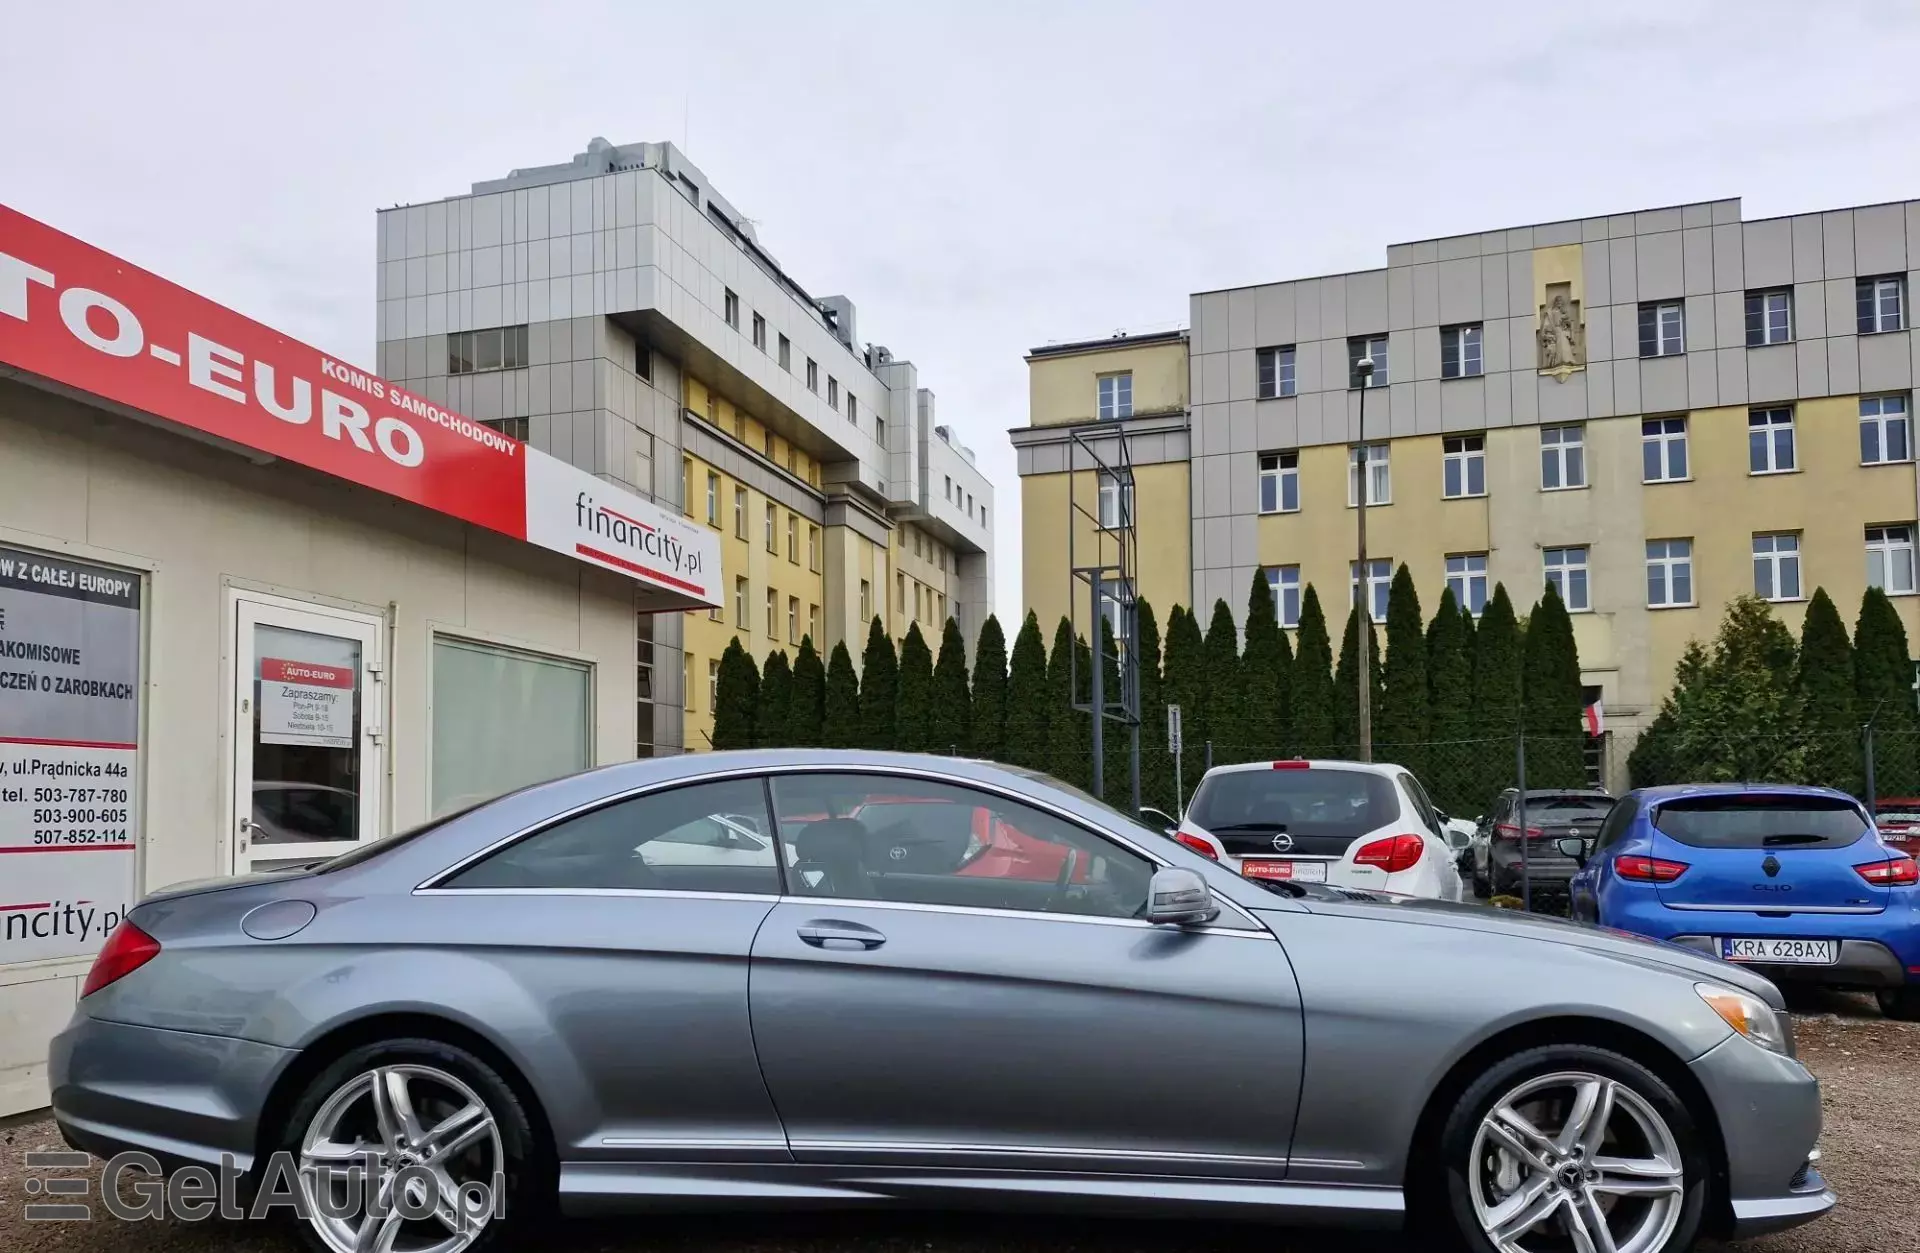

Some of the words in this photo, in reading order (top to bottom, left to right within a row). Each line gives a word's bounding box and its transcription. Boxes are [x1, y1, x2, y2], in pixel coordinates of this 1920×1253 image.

[321, 357, 384, 399] KOMIS
[390, 388, 516, 457] SAMOCHODOWY
[576, 491, 702, 576] financity.pl
[18, 562, 28, 580] Z
[31, 564, 75, 588] CAŁEJ
[79, 573, 131, 598] EUROPY
[286, 666, 336, 681] AUTO-EURO
[0, 670, 37, 692] CZEŃ
[41, 675, 51, 693] O
[55, 677, 133, 700] ZAROBKACH
[105, 762, 128, 778] 44a
[2, 787, 28, 803] tel.
[34, 788, 128, 803] 503-787-780
[33, 808, 127, 823] 503-900-605
[34, 828, 127, 845] 507-852-114
[1247, 866, 1291, 875] AUTO-EURO
[1752, 884, 1792, 892] CLIO
[1733, 940, 1767, 957] KRA
[1772, 941, 1827, 959] 628AX
